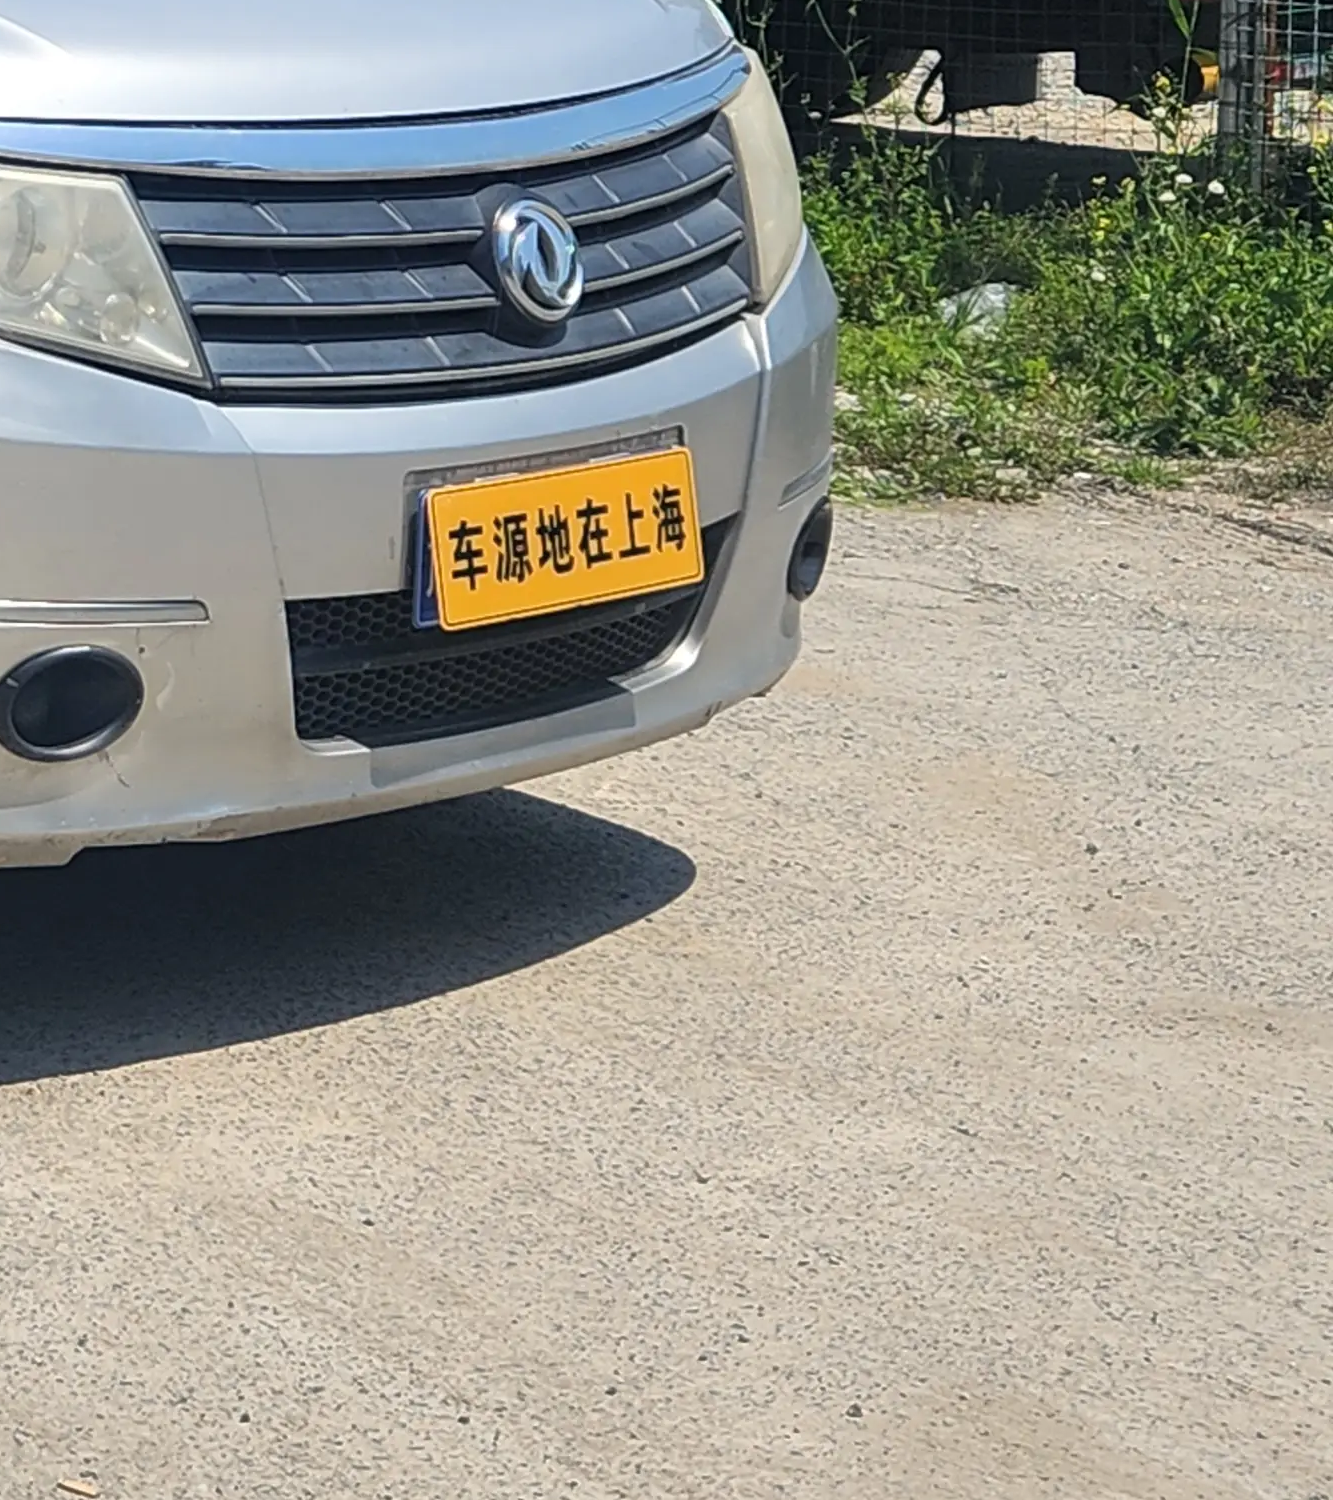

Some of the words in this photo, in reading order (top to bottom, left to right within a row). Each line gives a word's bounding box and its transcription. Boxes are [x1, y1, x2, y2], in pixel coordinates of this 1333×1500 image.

[448, 483, 688, 591] 车源地在上海
